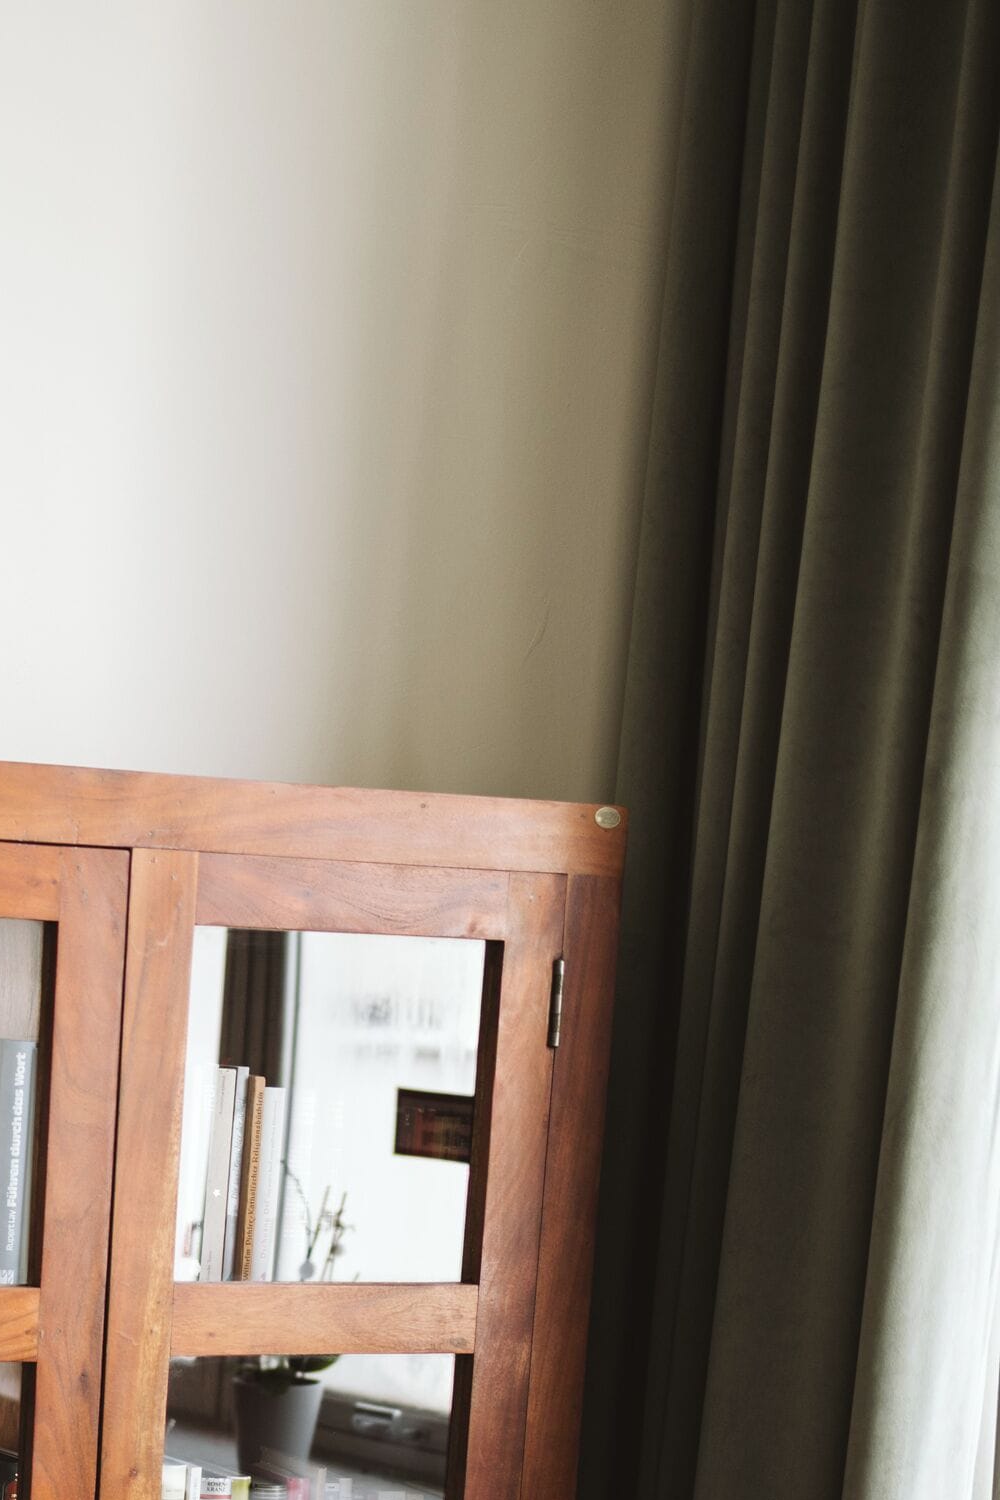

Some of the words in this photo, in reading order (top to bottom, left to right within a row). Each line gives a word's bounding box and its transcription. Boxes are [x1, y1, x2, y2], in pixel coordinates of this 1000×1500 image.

[14, 1052, 26, 1086] Wort
[11, 1089, 24, 1116] das
[9, 1117, 22, 1157] durch
[6, 1160, 21, 1207] Führen
